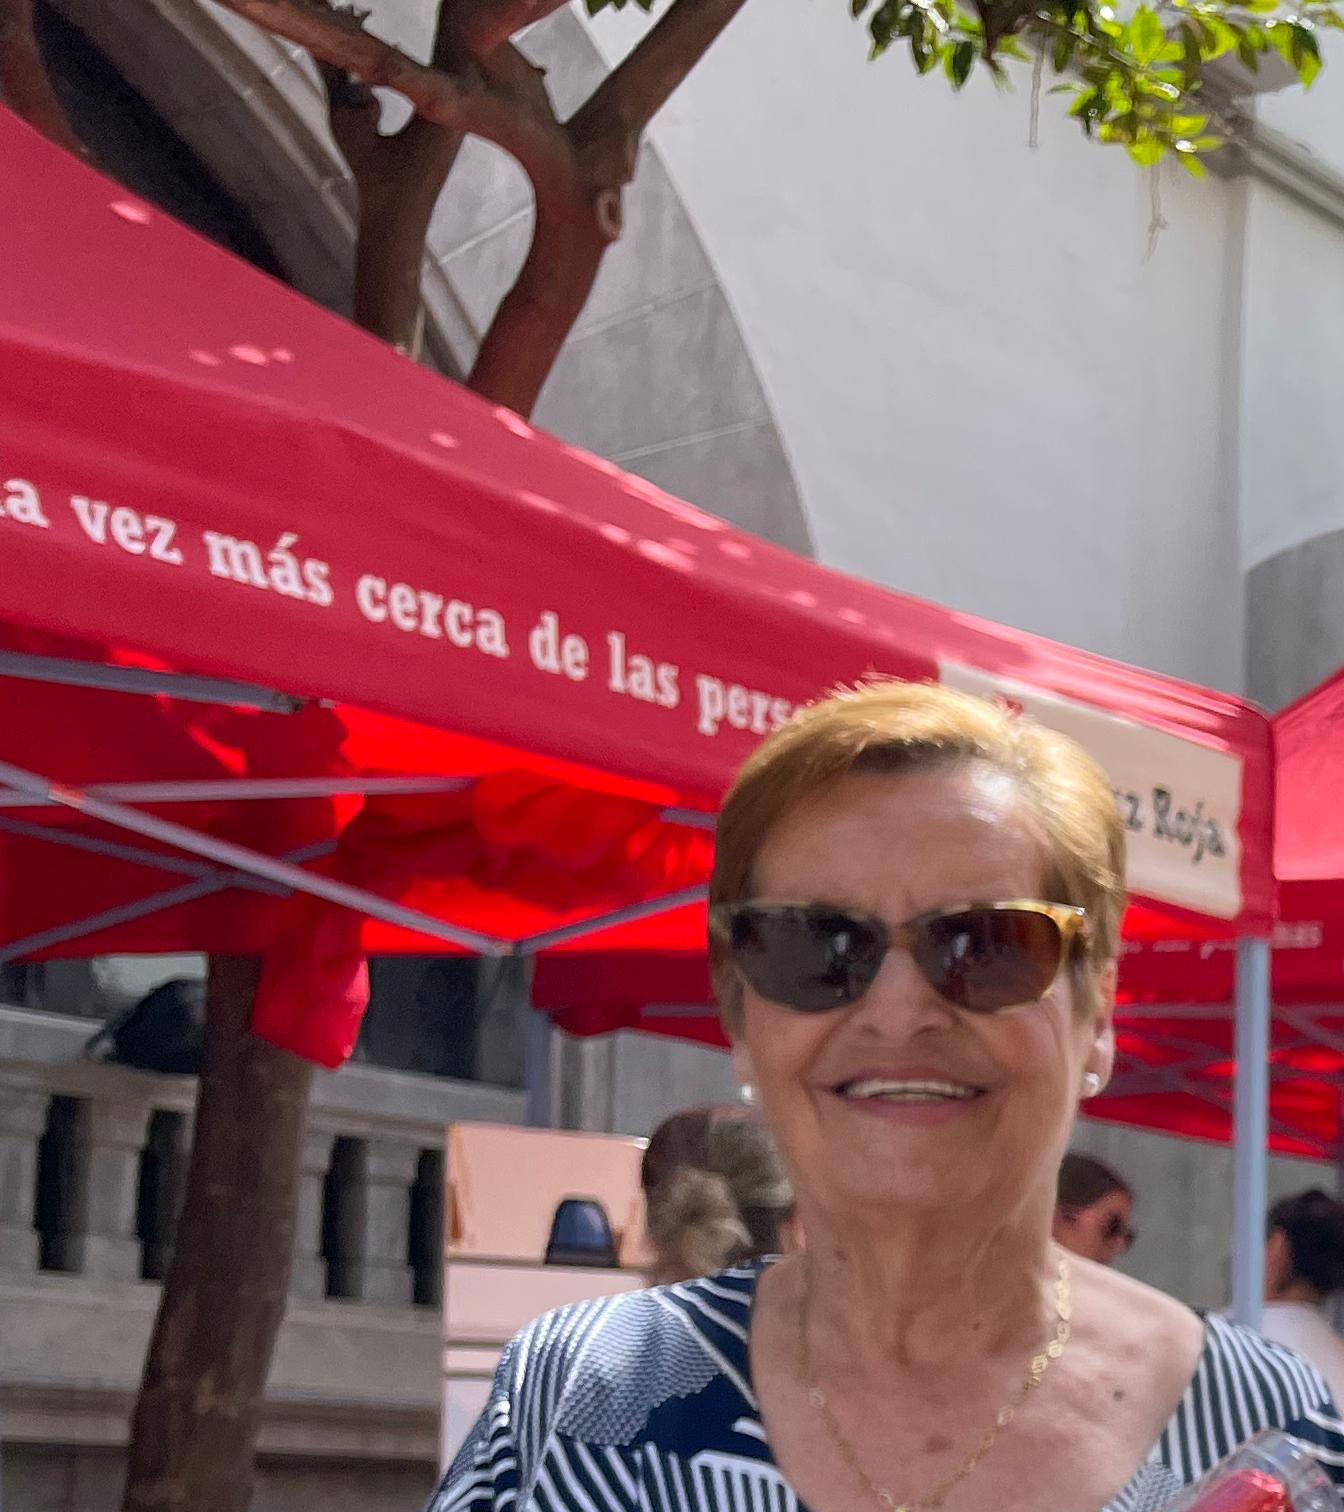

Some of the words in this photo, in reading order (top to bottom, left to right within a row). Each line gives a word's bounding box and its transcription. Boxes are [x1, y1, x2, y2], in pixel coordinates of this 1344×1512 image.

[70, 495, 184, 566] vez
[203, 531, 334, 606] más
[355, 573, 510, 658] cerca
[528, 610, 590, 682] de
[606, 630, 680, 709] las
[1152, 785, 1225, 864] Roja
